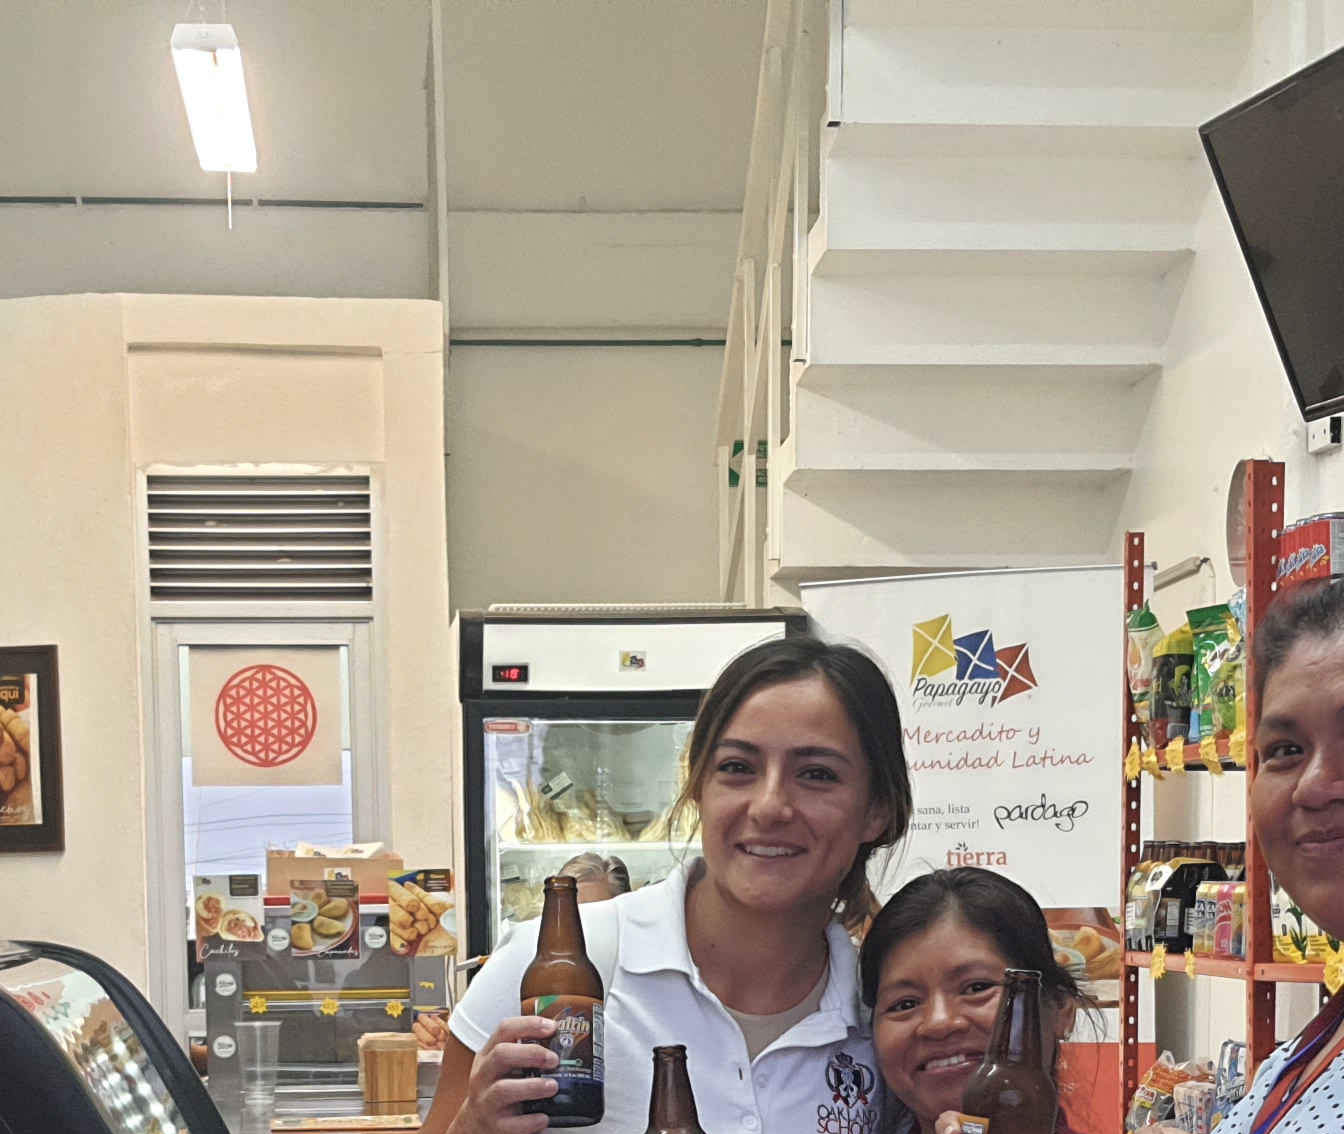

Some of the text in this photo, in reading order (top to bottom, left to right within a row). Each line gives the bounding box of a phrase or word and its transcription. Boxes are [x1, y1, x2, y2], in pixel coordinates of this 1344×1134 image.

[913, 676, 1002, 706] Papagayo
[902, 722, 1041, 745] Mercadito y
[906, 748, 1094, 773] unidad Latina
[917, 803, 970, 817] sana, lista
[945, 818, 979, 830] servir!
[946, 845, 1008, 867] tierra
